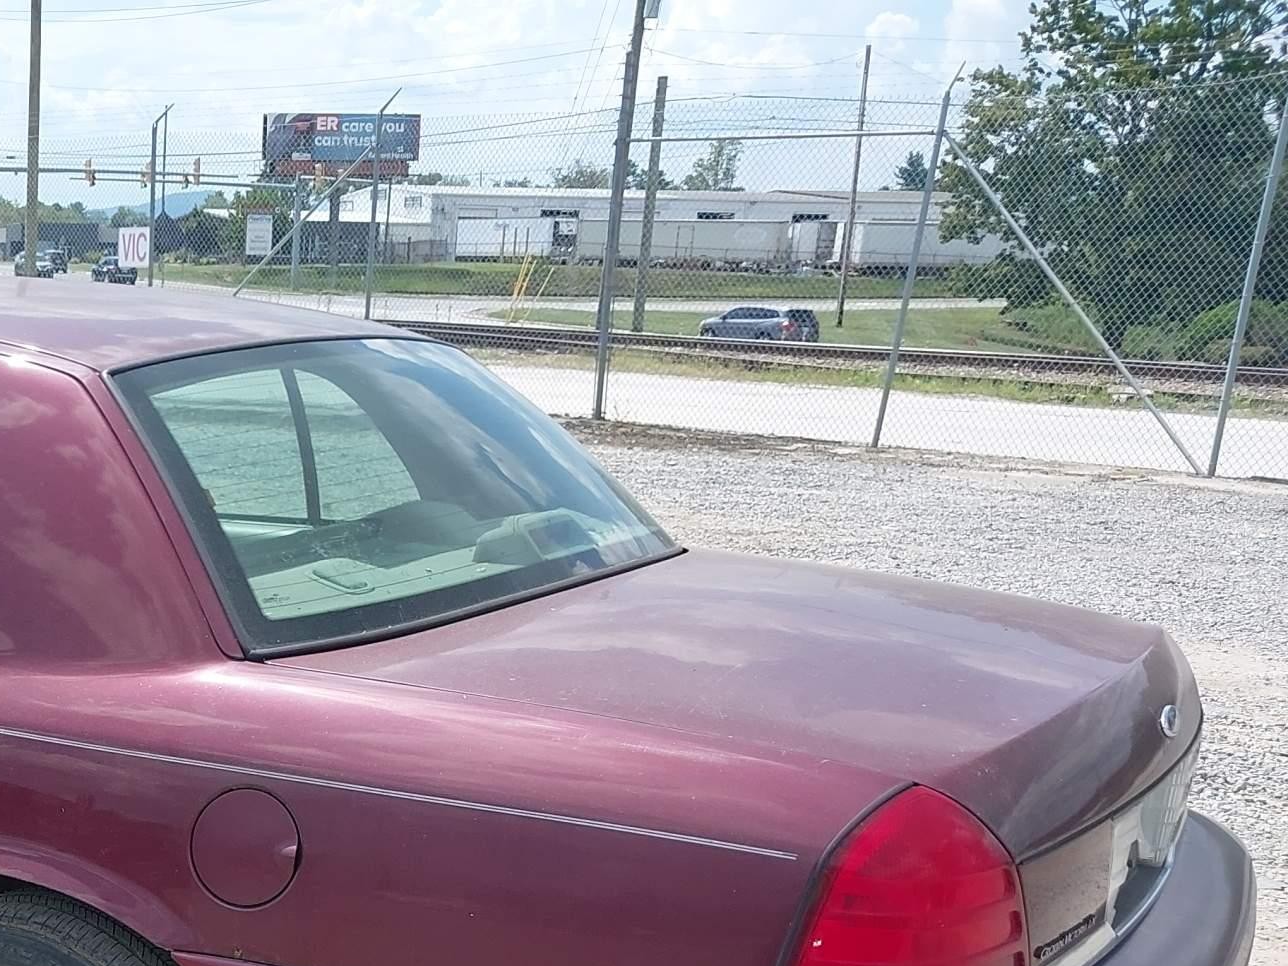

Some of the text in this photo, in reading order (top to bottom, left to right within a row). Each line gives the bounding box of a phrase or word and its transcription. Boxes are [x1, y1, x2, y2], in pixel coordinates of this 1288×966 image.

[316, 116, 338, 130] ER
[342, 121, 374, 133] care
[314, 135, 341, 146] can
[122, 232, 148, 262] VIC
